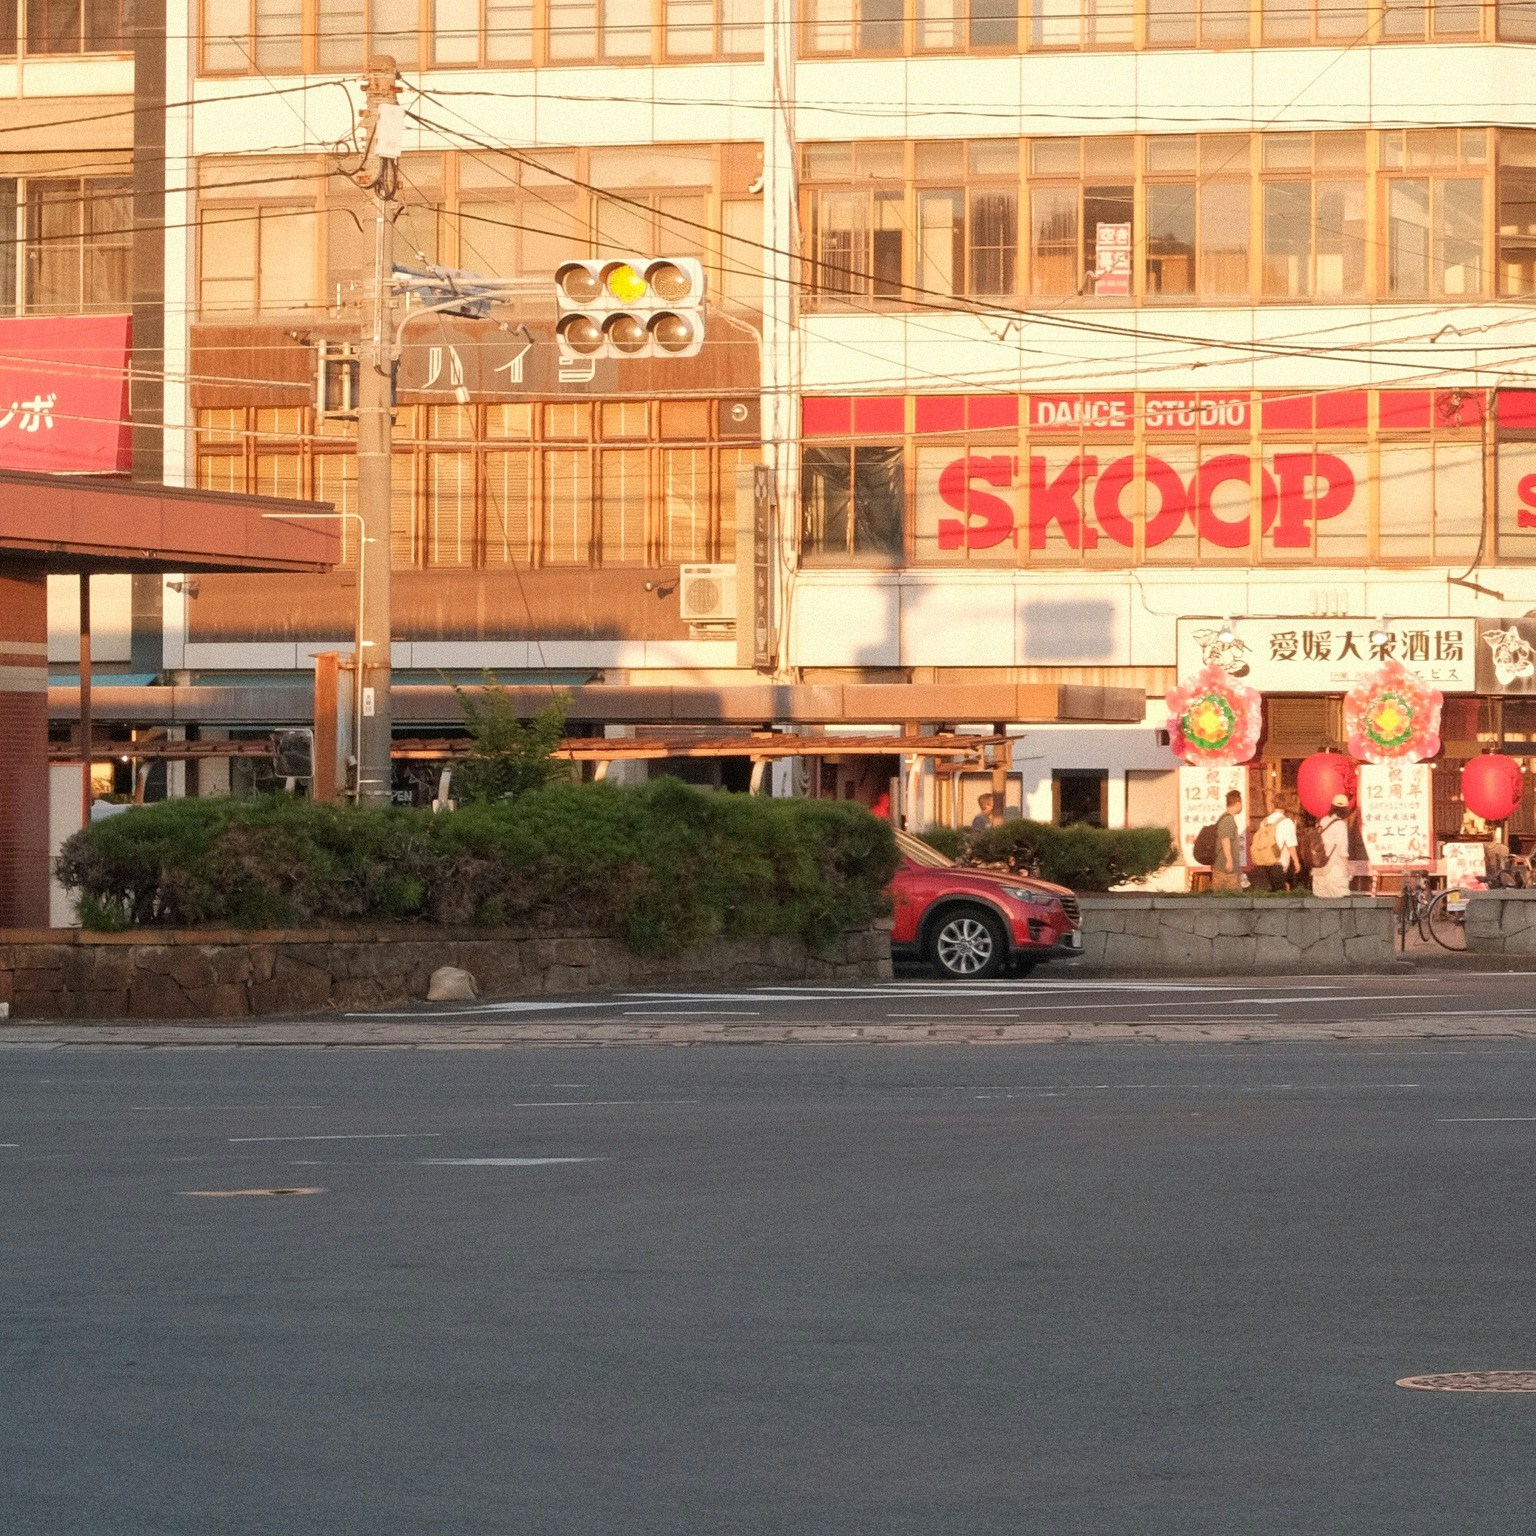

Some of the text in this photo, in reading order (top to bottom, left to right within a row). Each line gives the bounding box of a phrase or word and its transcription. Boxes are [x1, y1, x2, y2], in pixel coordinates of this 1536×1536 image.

[1037, 399, 1245, 428] DANCE STUDIO
[937, 452, 1357, 550] SKOOP
[1269, 629, 1464, 662] 愛媛大衆酒場
